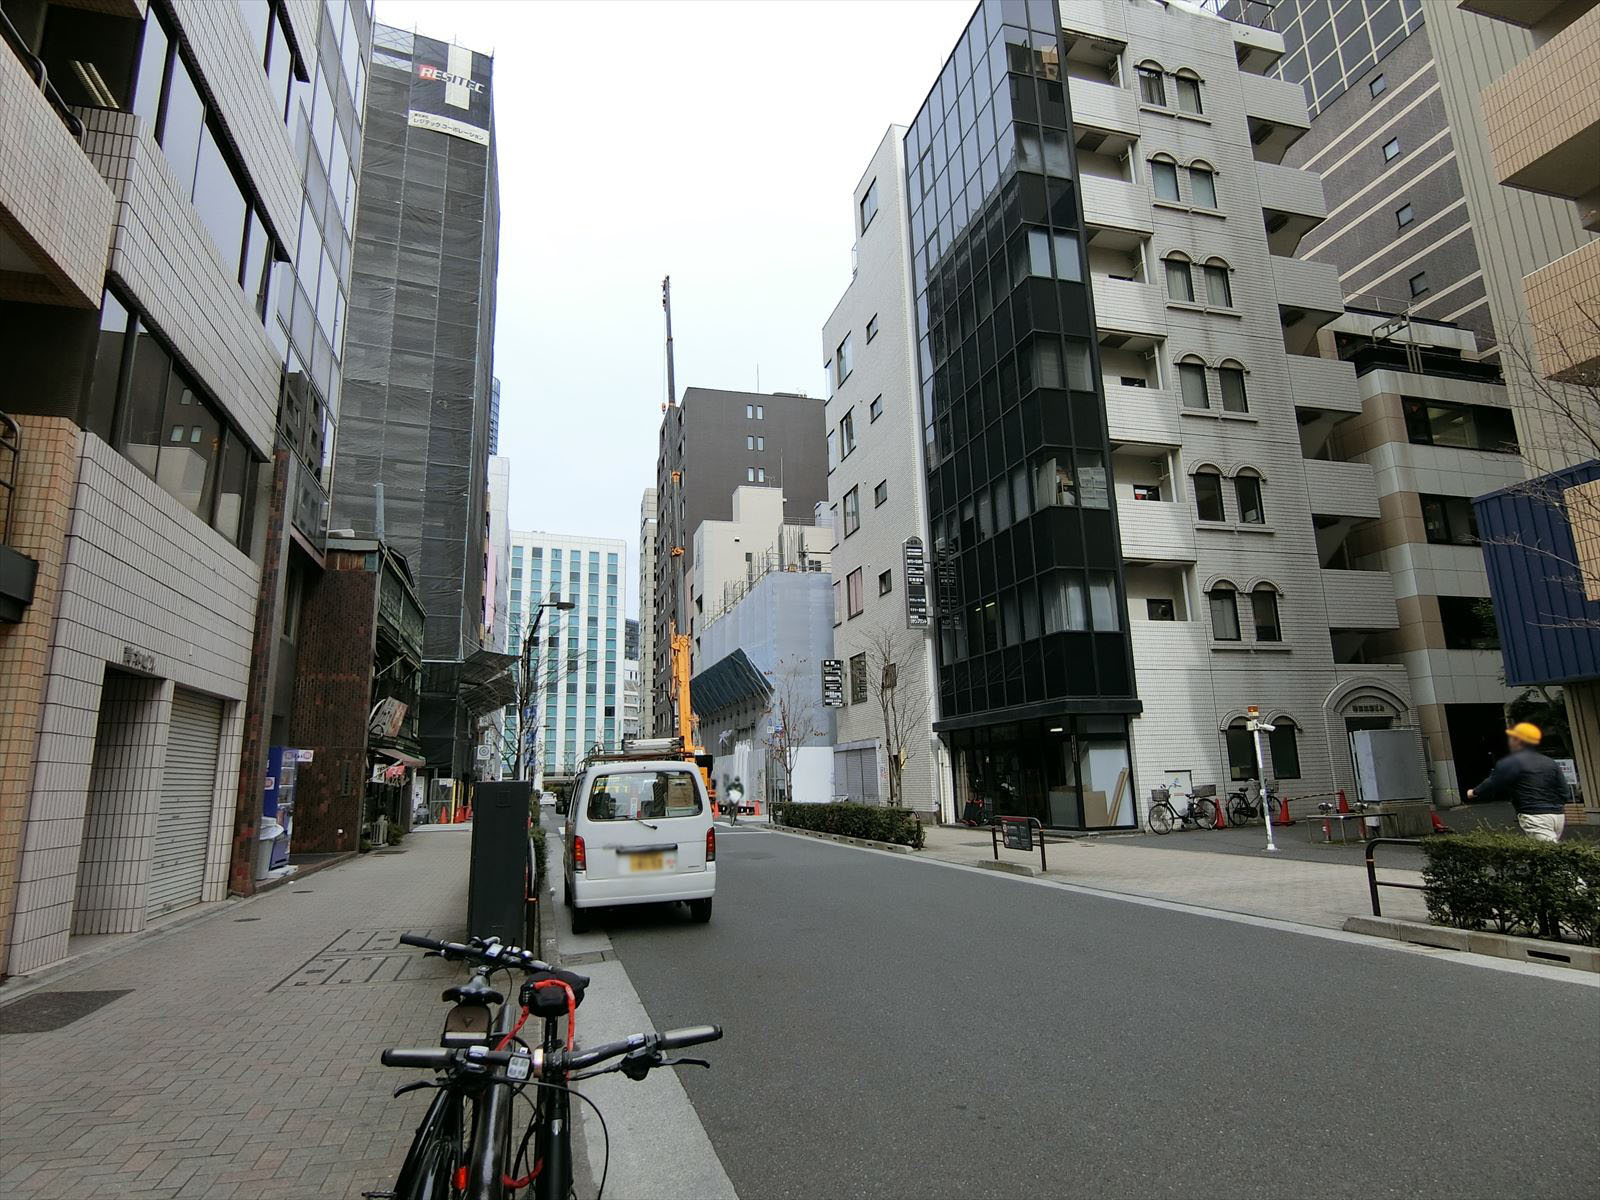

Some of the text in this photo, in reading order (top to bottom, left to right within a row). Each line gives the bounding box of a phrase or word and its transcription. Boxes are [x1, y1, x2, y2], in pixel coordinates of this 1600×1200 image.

[420, 67, 485, 94] RESITEC
[413, 118, 485, 141] レジテック コーポレーション
